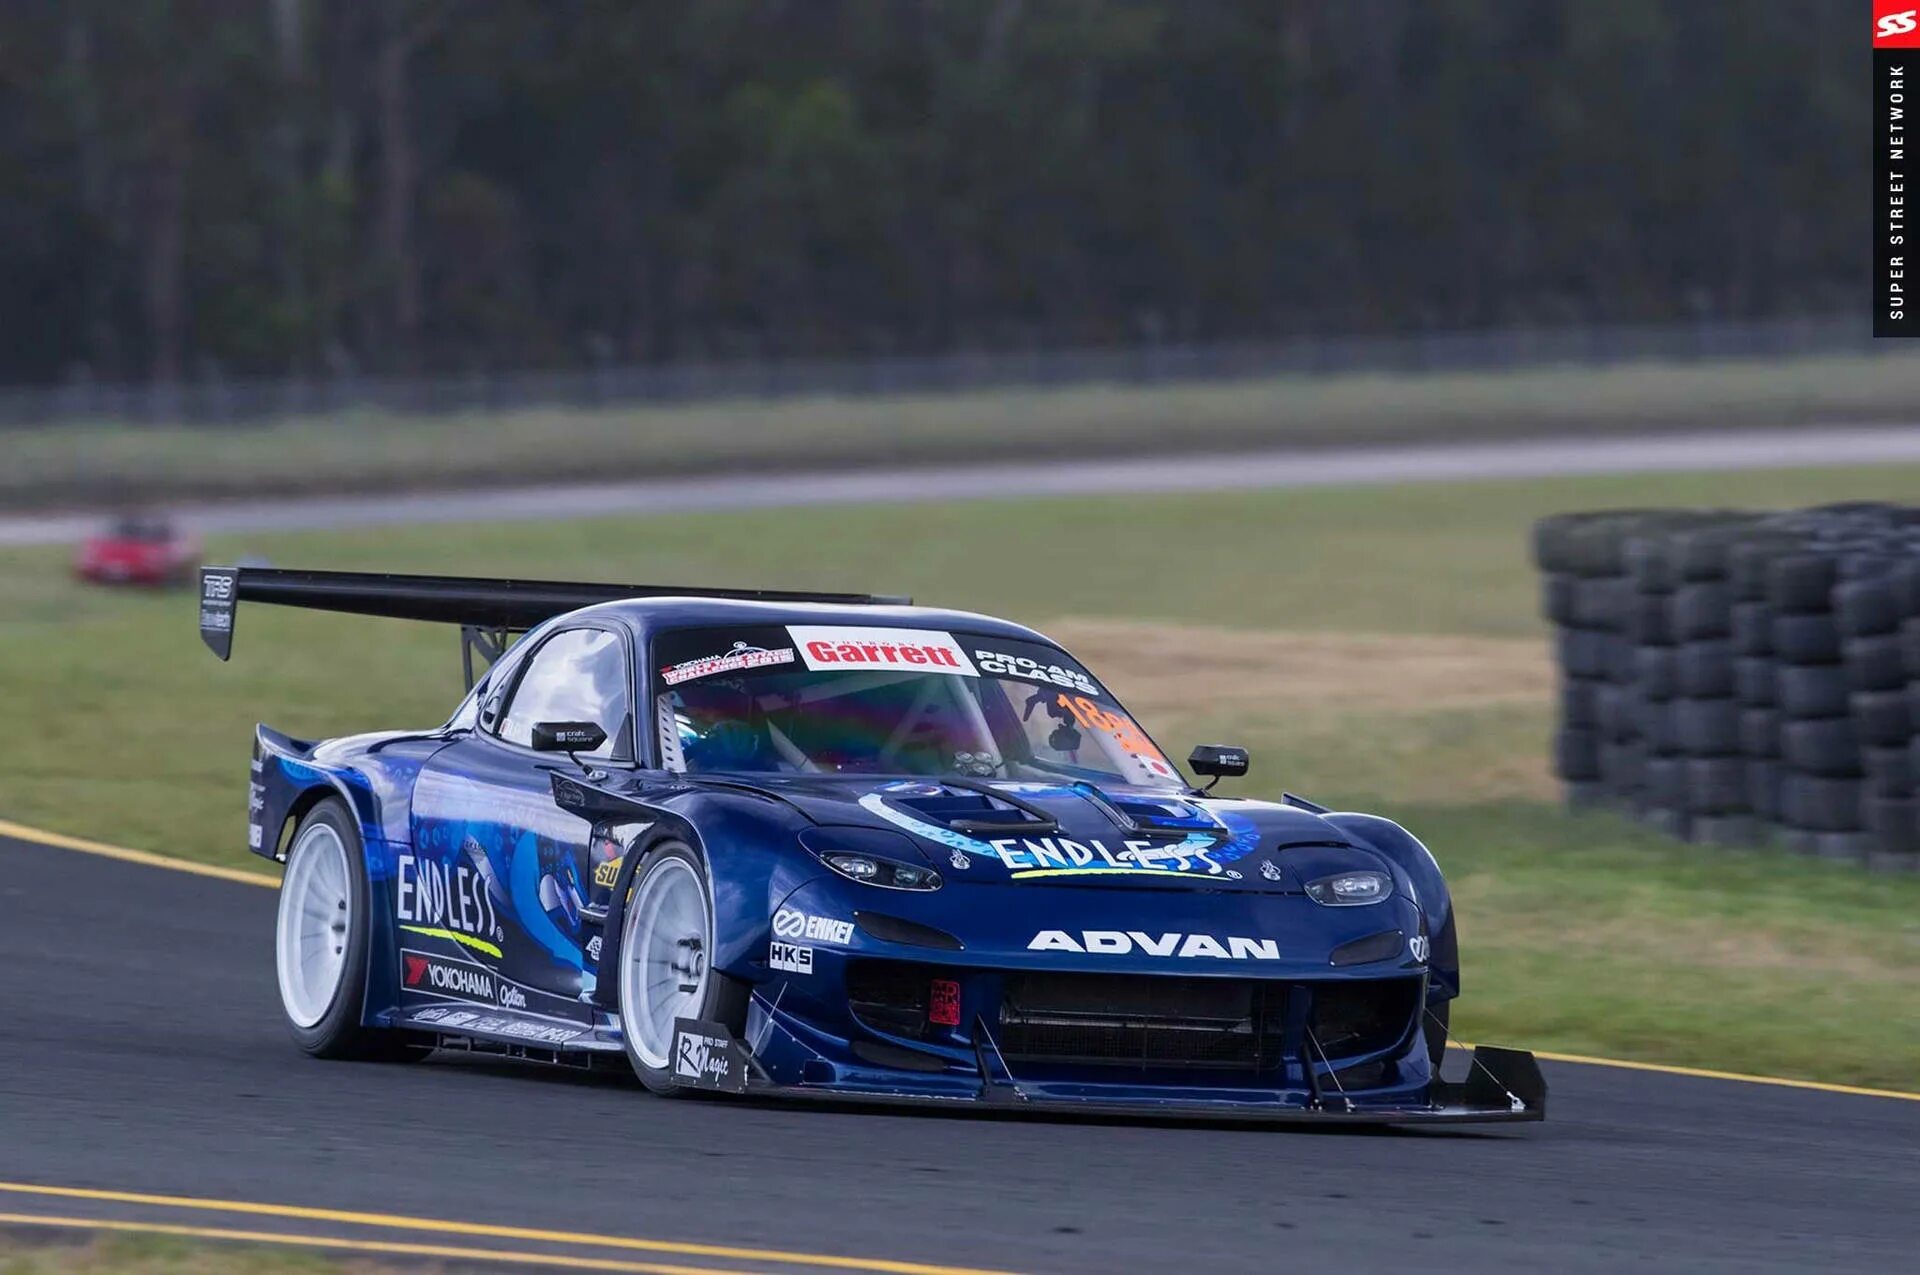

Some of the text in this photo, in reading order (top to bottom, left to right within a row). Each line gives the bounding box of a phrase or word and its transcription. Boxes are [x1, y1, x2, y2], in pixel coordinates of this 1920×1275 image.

[806, 641, 960, 667] Garrett
[975, 650, 1088, 683] PRO-AM
[980, 660, 1099, 695] CLASS
[805, 916, 855, 945] ENKEI
[1027, 930, 1280, 960] ADVAN
[771, 944, 812, 967] HKS
[428, 964, 493, 998] YOKOHAMA
